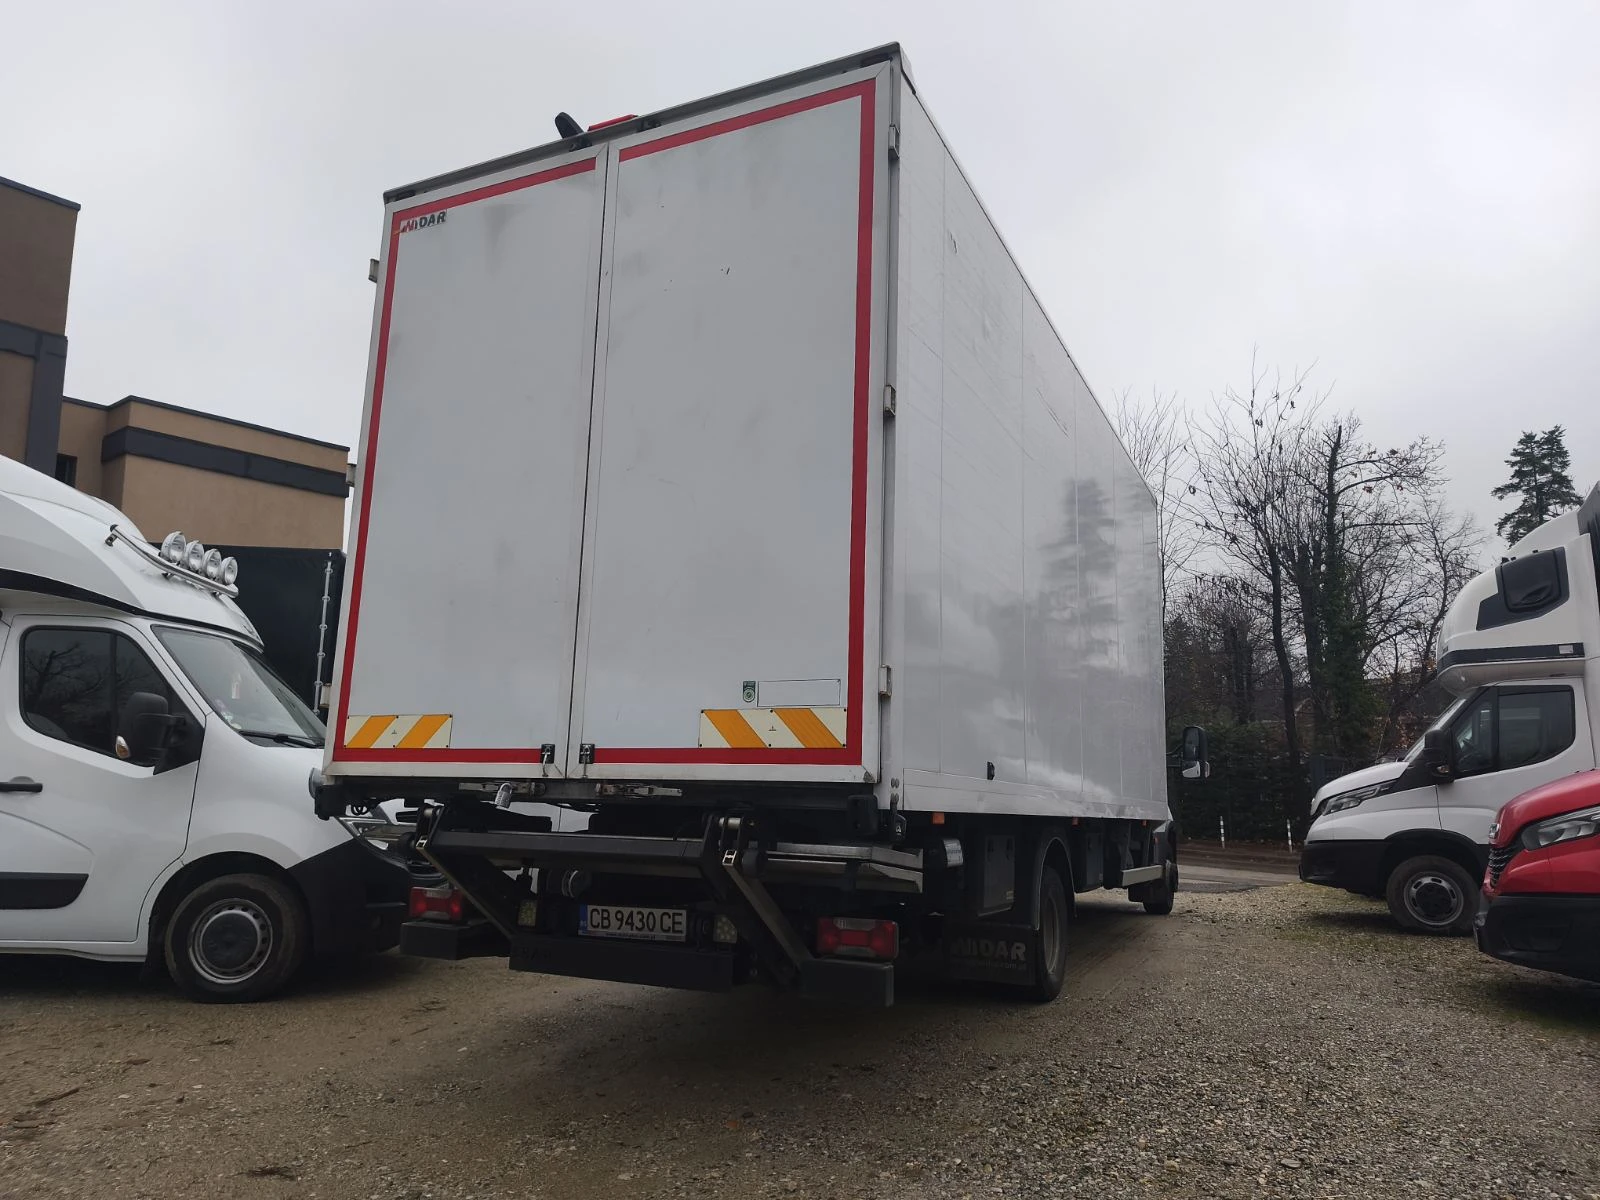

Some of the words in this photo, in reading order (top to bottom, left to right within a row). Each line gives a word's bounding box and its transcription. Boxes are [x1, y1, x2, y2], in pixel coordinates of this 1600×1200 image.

[589, 908, 611, 929] CB
[614, 909, 656, 932] 9430
[660, 911, 683, 934] CE
